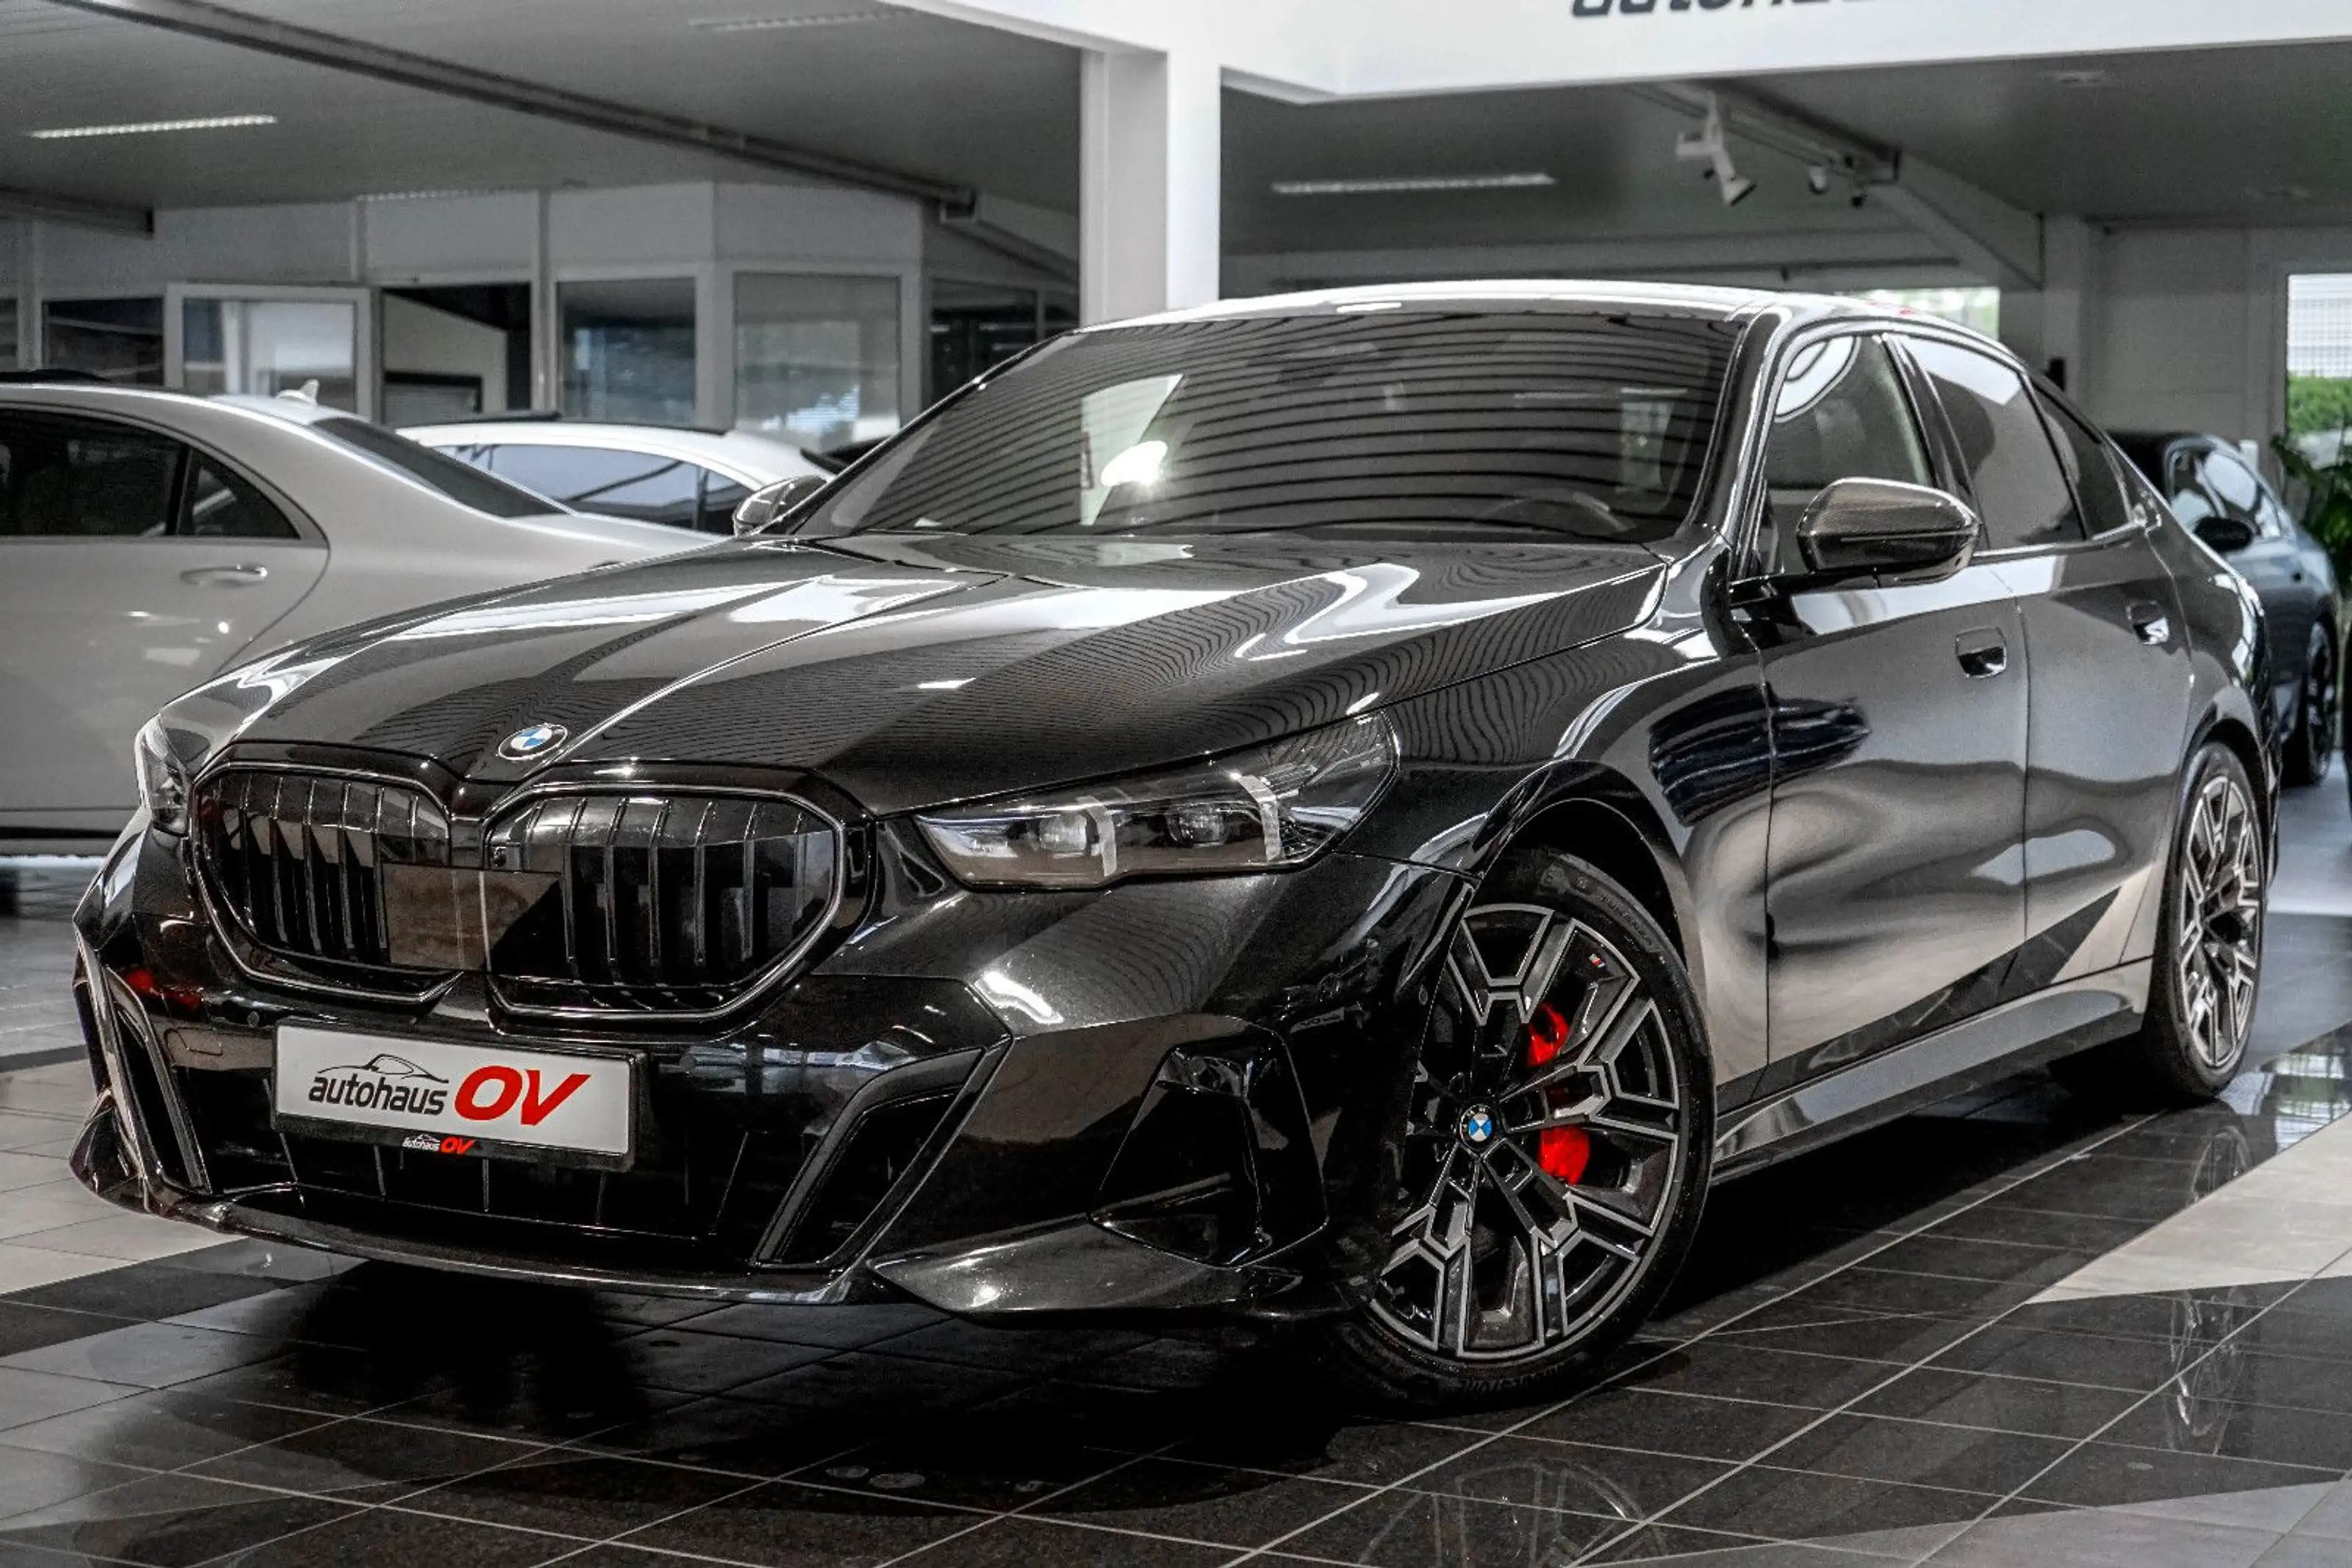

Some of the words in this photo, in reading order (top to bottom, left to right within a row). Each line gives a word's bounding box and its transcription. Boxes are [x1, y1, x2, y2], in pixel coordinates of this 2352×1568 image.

[307, 1072, 448, 1116] autohaus
[454, 1065, 590, 1126] OV
[440, 1136, 476, 1155] OV
